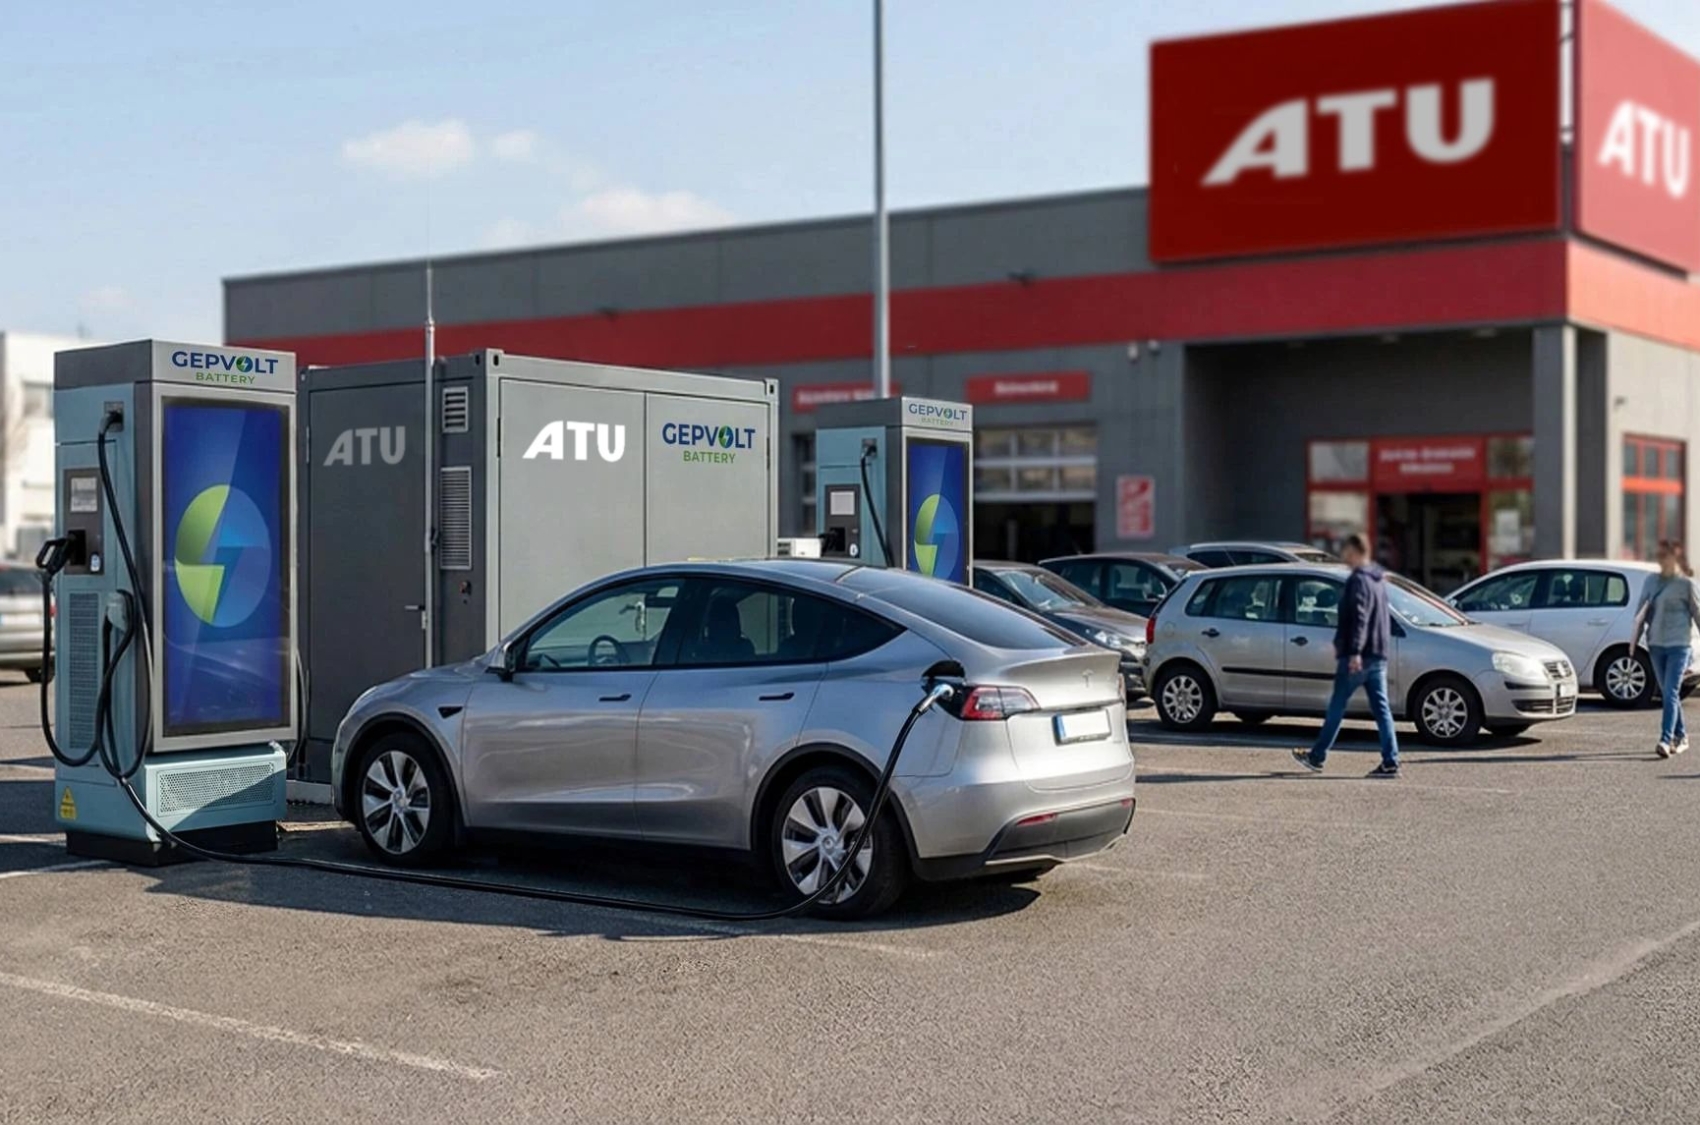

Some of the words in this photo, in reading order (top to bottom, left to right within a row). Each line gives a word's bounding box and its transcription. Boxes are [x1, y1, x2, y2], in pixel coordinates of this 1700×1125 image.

[1201, 78, 1494, 186] ATU
[1598, 100, 1690, 199] ATU
[172, 351, 278, 374] GEPVOLT
[195, 372, 255, 384] BATTERY
[908, 403, 967, 420] GEPVOLT
[323, 425, 406, 466] ATU
[522, 420, 625, 462] ATU
[662, 422, 755, 449] GEPVOLT
[683, 451, 736, 464] BATTERY
